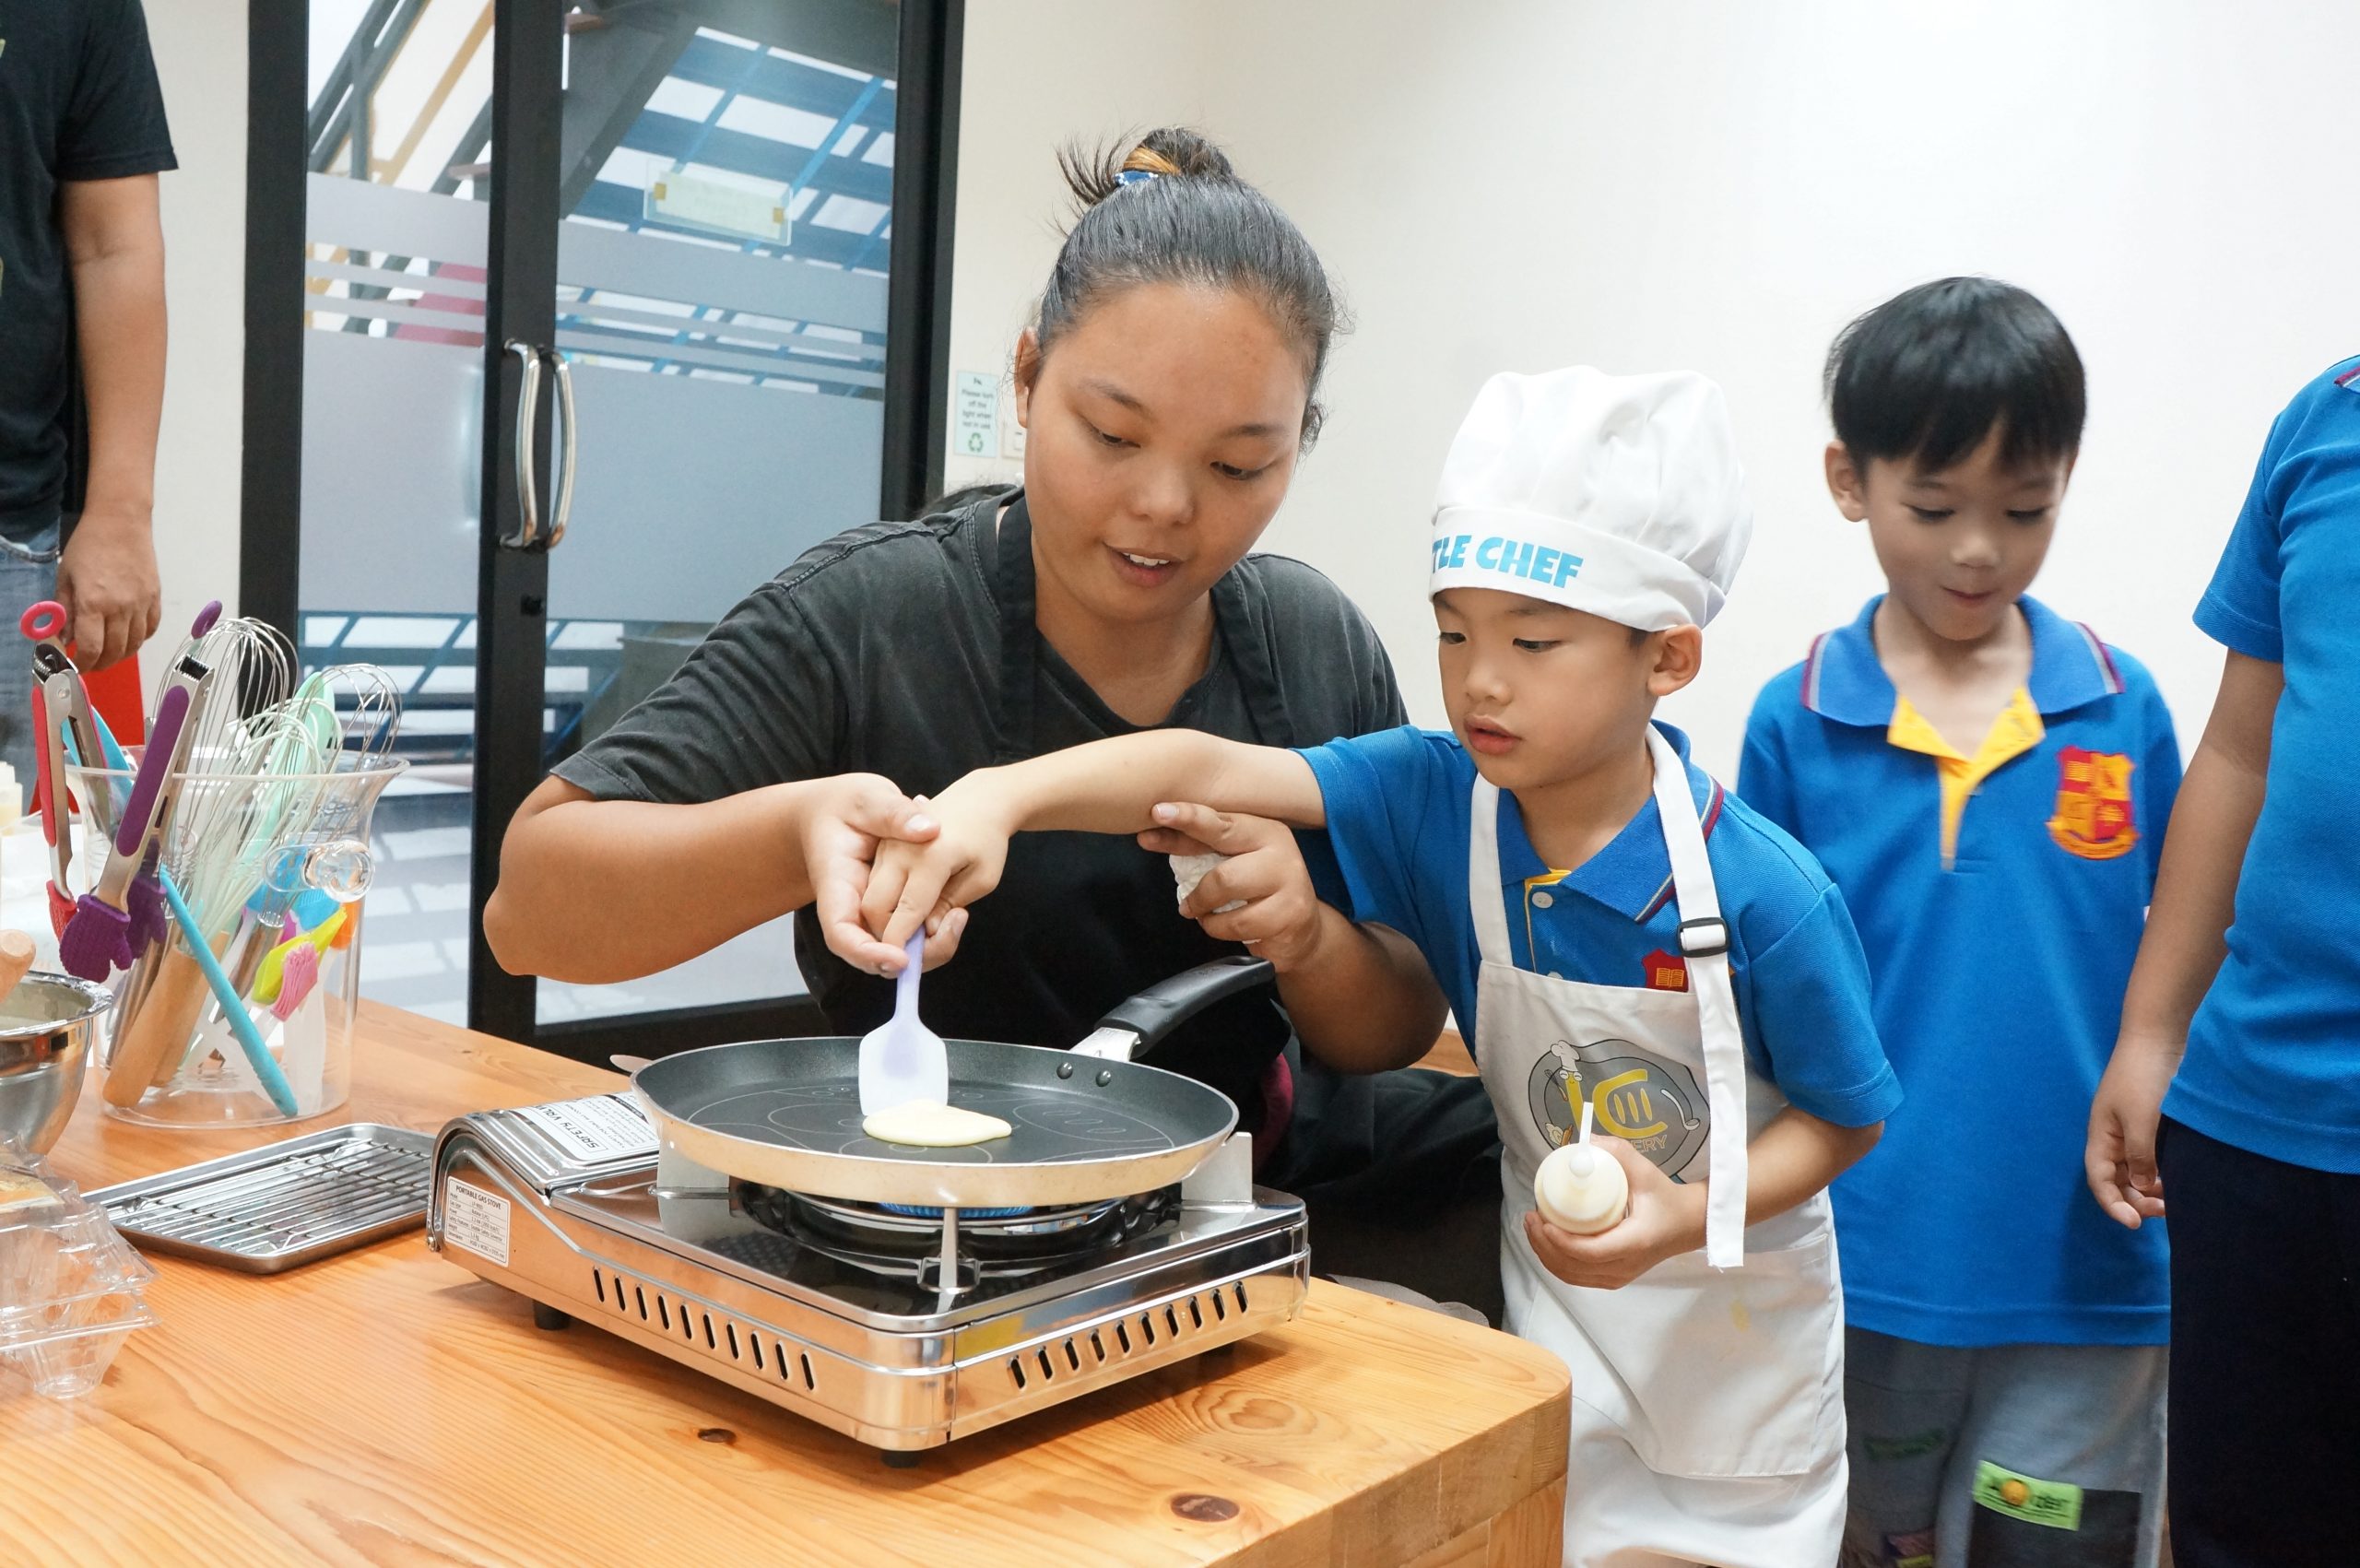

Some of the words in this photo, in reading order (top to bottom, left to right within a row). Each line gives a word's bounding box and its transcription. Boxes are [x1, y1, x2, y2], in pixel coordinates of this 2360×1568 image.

[962, 389, 980, 397] Please
[1476, 536, 1584, 588] CHEF
[560, 1122, 599, 1149] SAFETY
[455, 1185, 478, 1200] PORTABLE
[478, 1195, 487, 1203] GAS
[488, 1198, 501, 1209] STOVE
